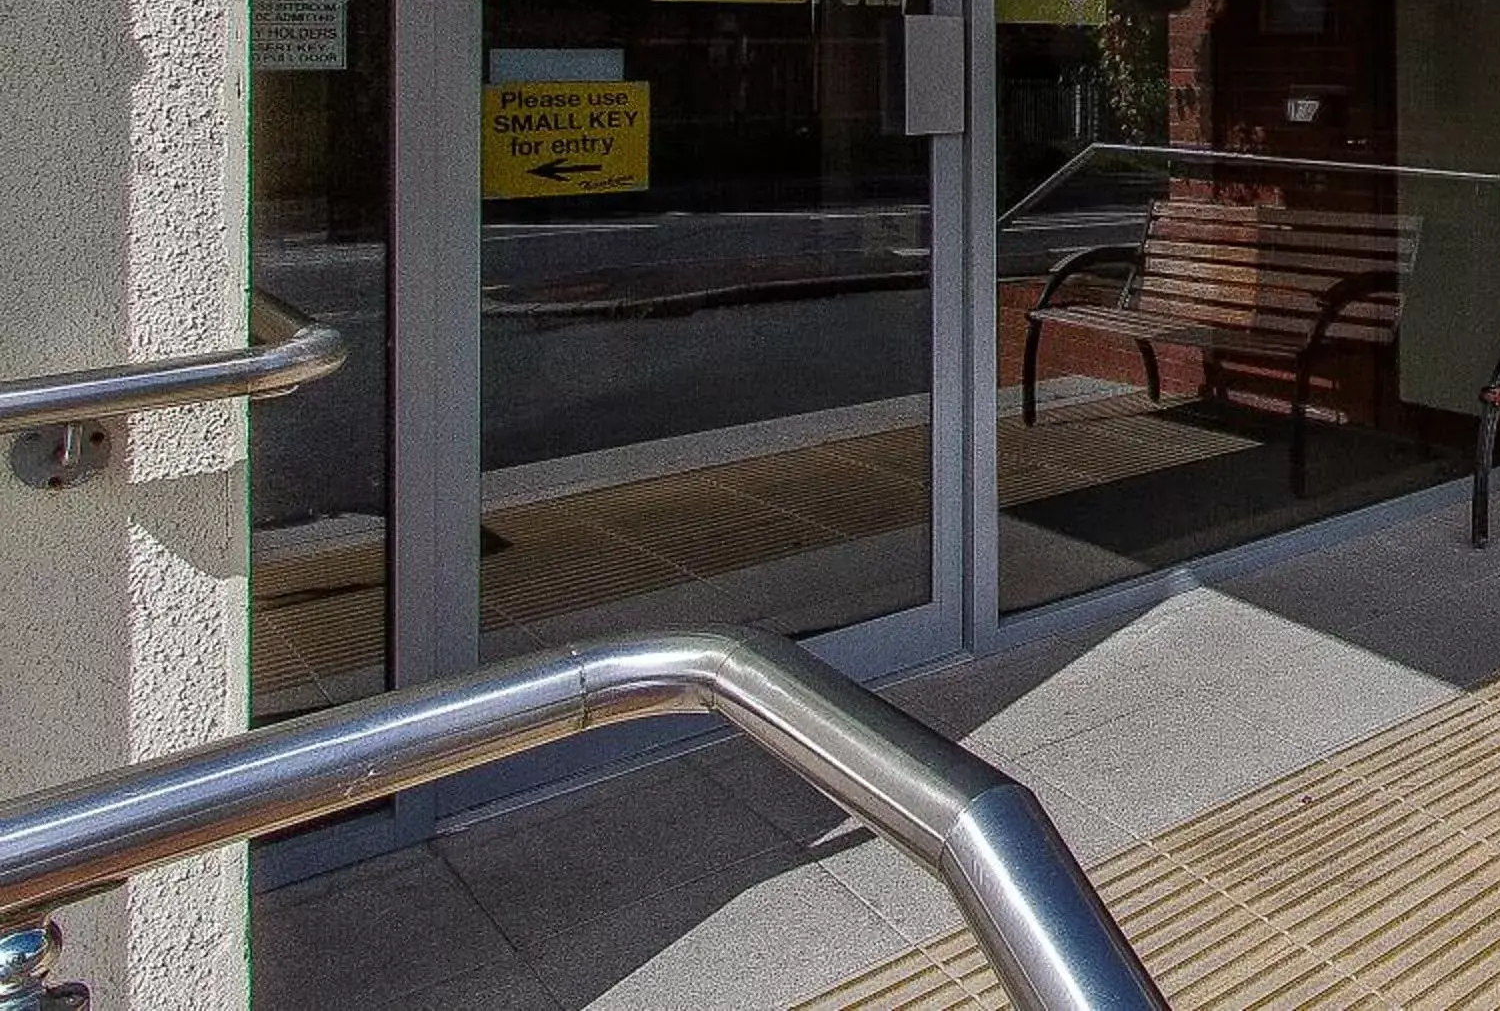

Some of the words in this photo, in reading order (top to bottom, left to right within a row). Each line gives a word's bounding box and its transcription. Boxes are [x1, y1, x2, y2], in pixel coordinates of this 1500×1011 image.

[267, 28, 336, 40] HOLDERS
[501, 91, 580, 109] Please
[588, 92, 627, 107] use
[494, 113, 583, 133] SMALL
[590, 111, 638, 128] KEY
[511, 137, 542, 157] for
[552, 134, 613, 156] entry
